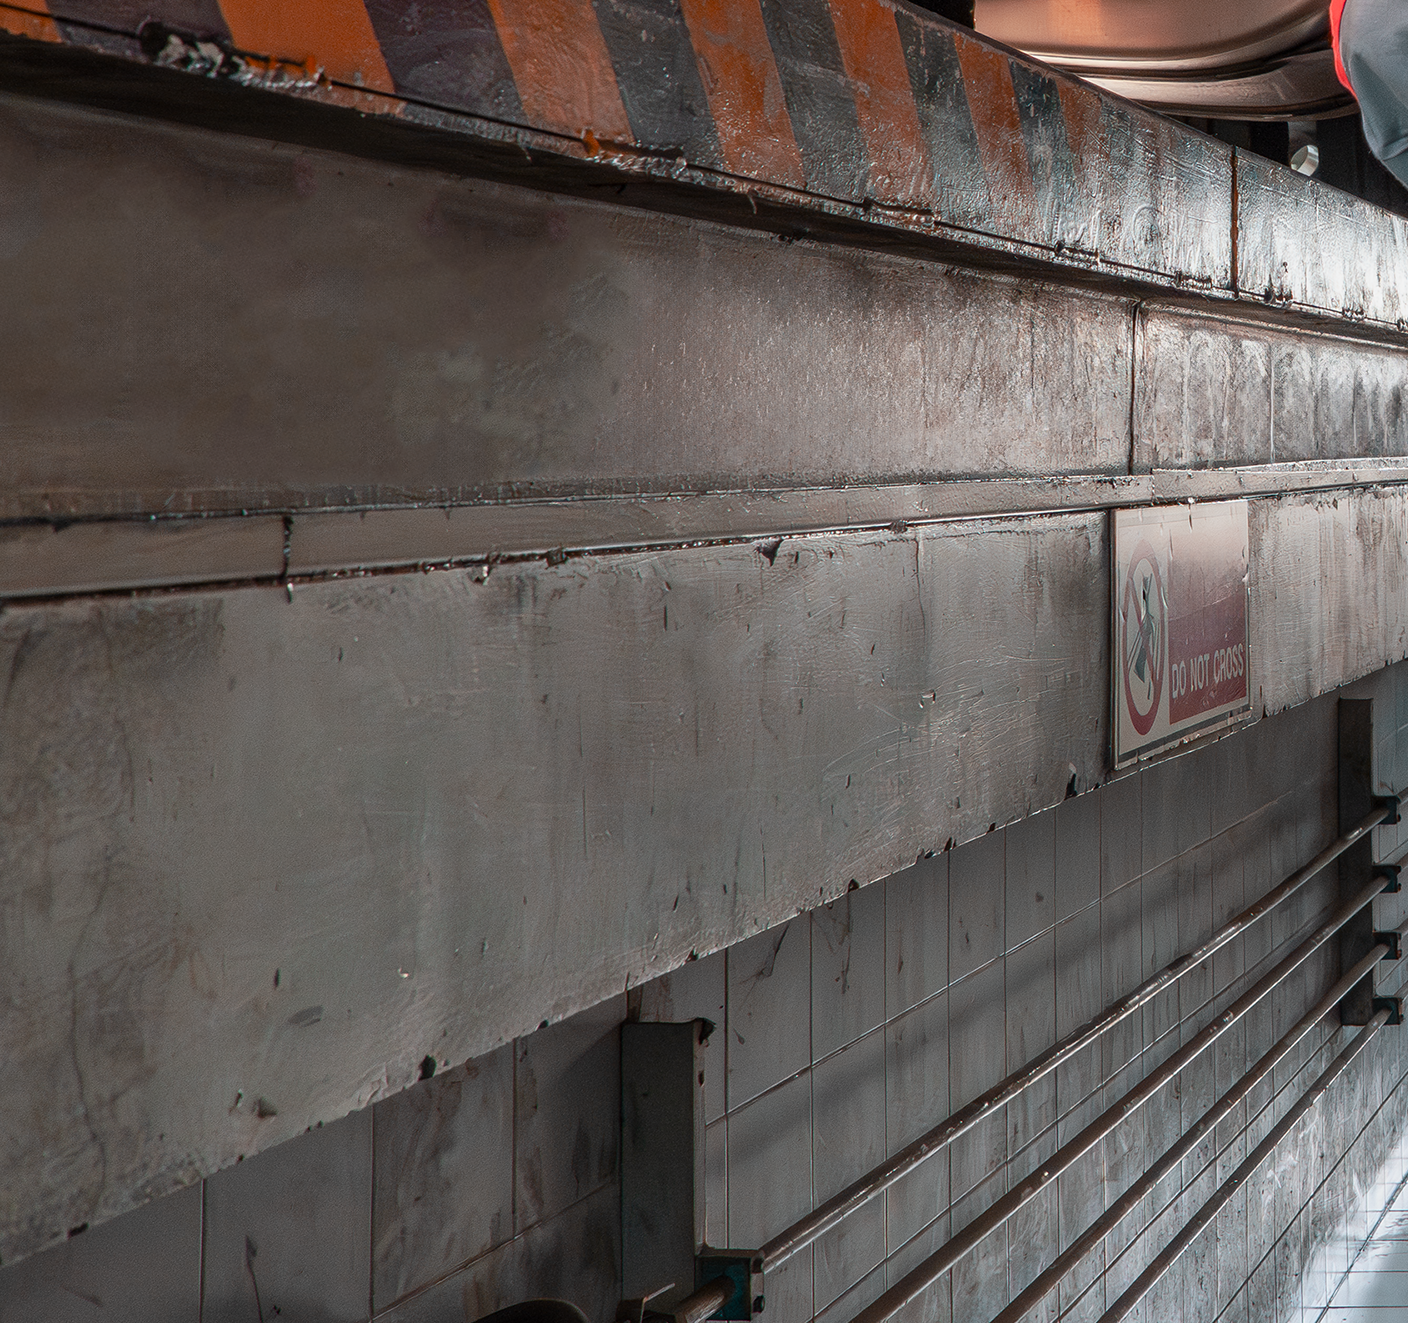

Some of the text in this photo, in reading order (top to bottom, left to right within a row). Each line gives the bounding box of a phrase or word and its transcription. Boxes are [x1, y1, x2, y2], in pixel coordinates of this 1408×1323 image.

[1172, 643, 1244, 699] DO NOT CROSS
